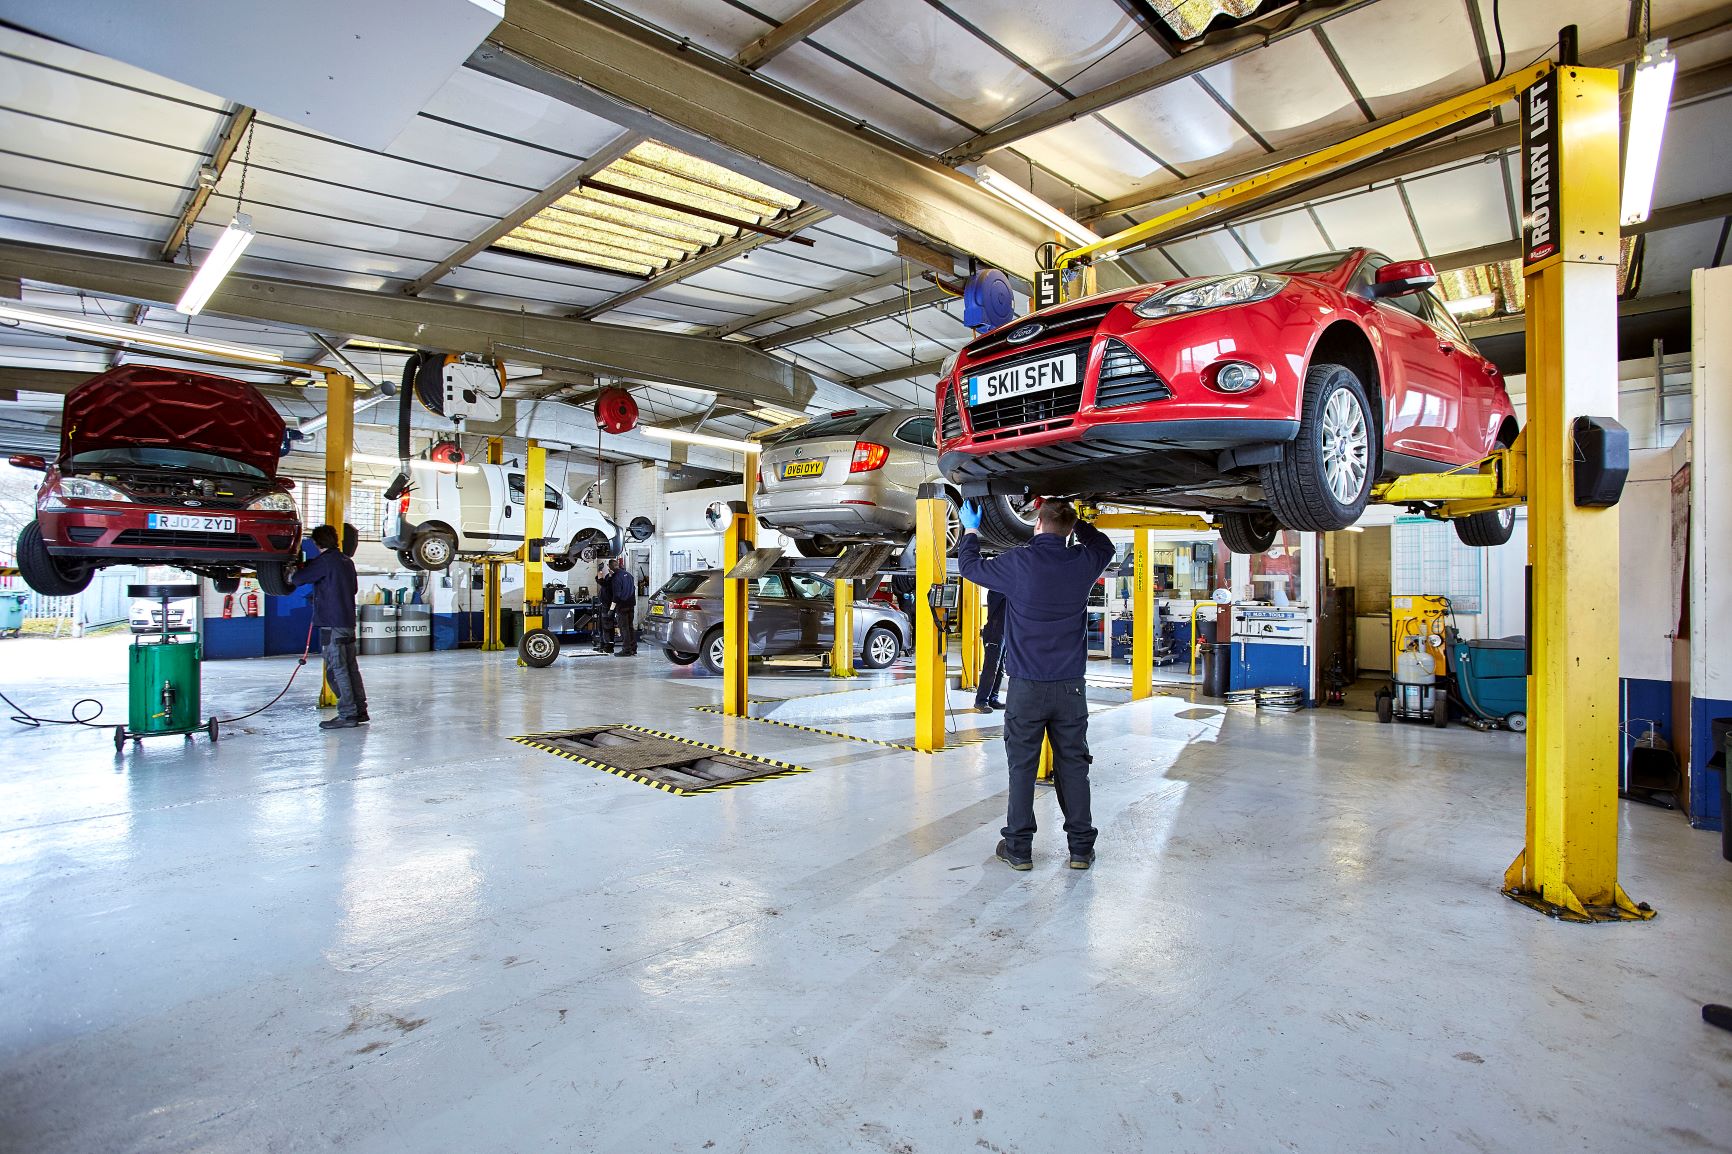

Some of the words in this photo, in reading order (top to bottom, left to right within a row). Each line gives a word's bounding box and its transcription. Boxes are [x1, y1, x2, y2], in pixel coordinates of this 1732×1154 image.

[1530, 81, 1548, 139] LIFT
[1531, 143, 1549, 247] ROTARY
[1041, 272, 1054, 305] LIFT
[1013, 325, 1034, 339] Ford
[1024, 359, 1064, 389] SFN
[160, 516, 200, 529] RJ02
[204, 518, 232, 531] ZYD
